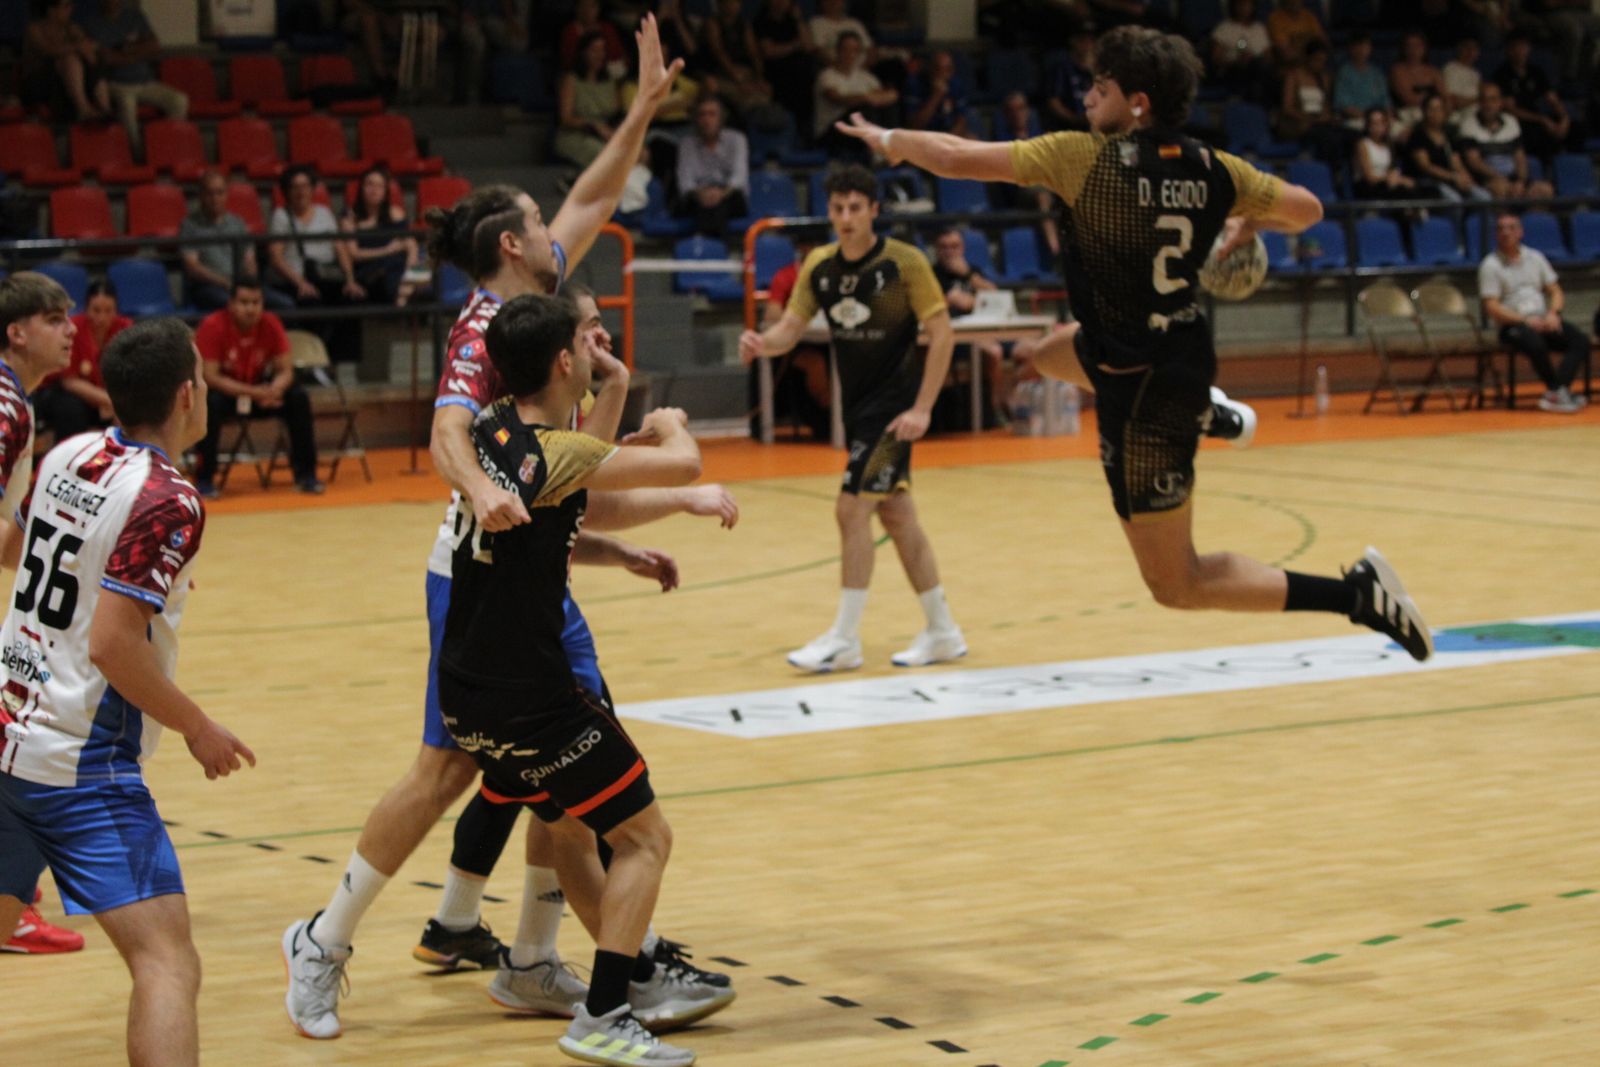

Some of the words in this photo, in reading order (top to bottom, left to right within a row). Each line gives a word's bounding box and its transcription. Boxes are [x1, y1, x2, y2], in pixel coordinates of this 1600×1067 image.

[1161, 178, 1208, 209] EGIDO
[1152, 214, 1194, 295] 2
[13, 515, 85, 632] 56
